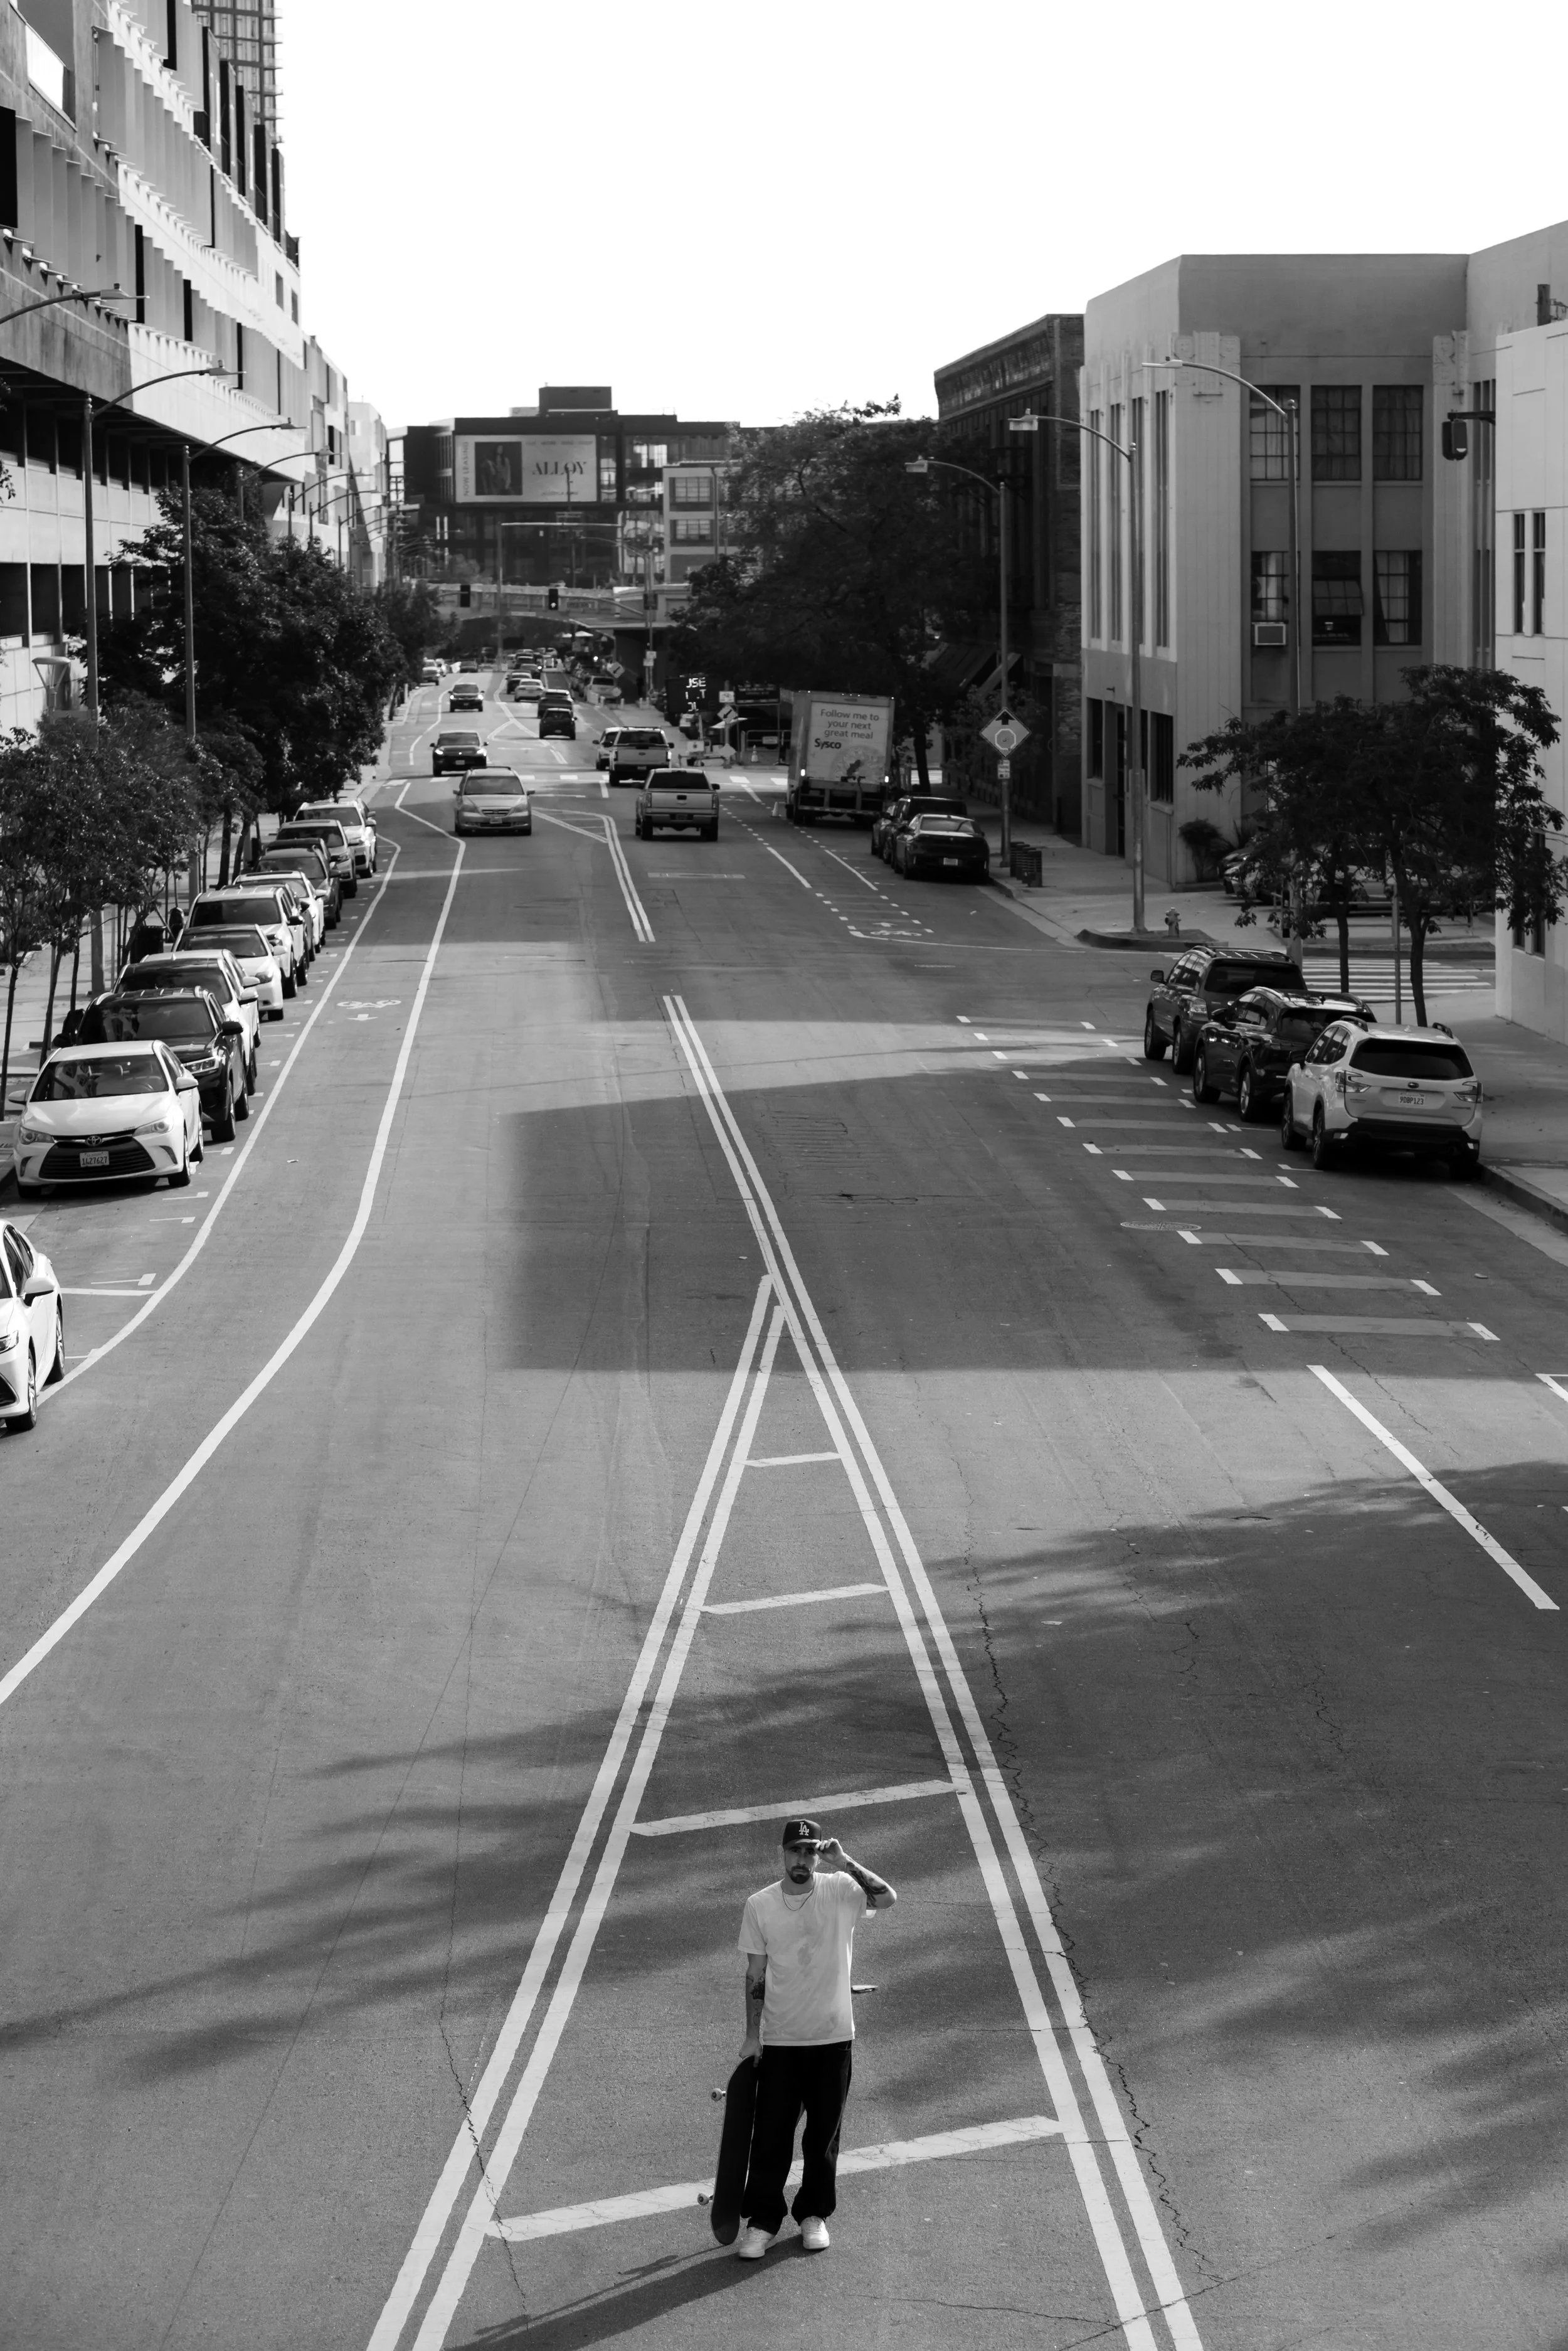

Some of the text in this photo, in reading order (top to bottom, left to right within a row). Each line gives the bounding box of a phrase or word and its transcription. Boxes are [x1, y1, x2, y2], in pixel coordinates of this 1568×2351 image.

[532, 461, 587, 475] ALLOY
[820, 709, 850, 719] Follow
[824, 730, 849, 738] great
[814, 738, 842, 750] Sysco
[798, 1822, 810, 1836] LA
